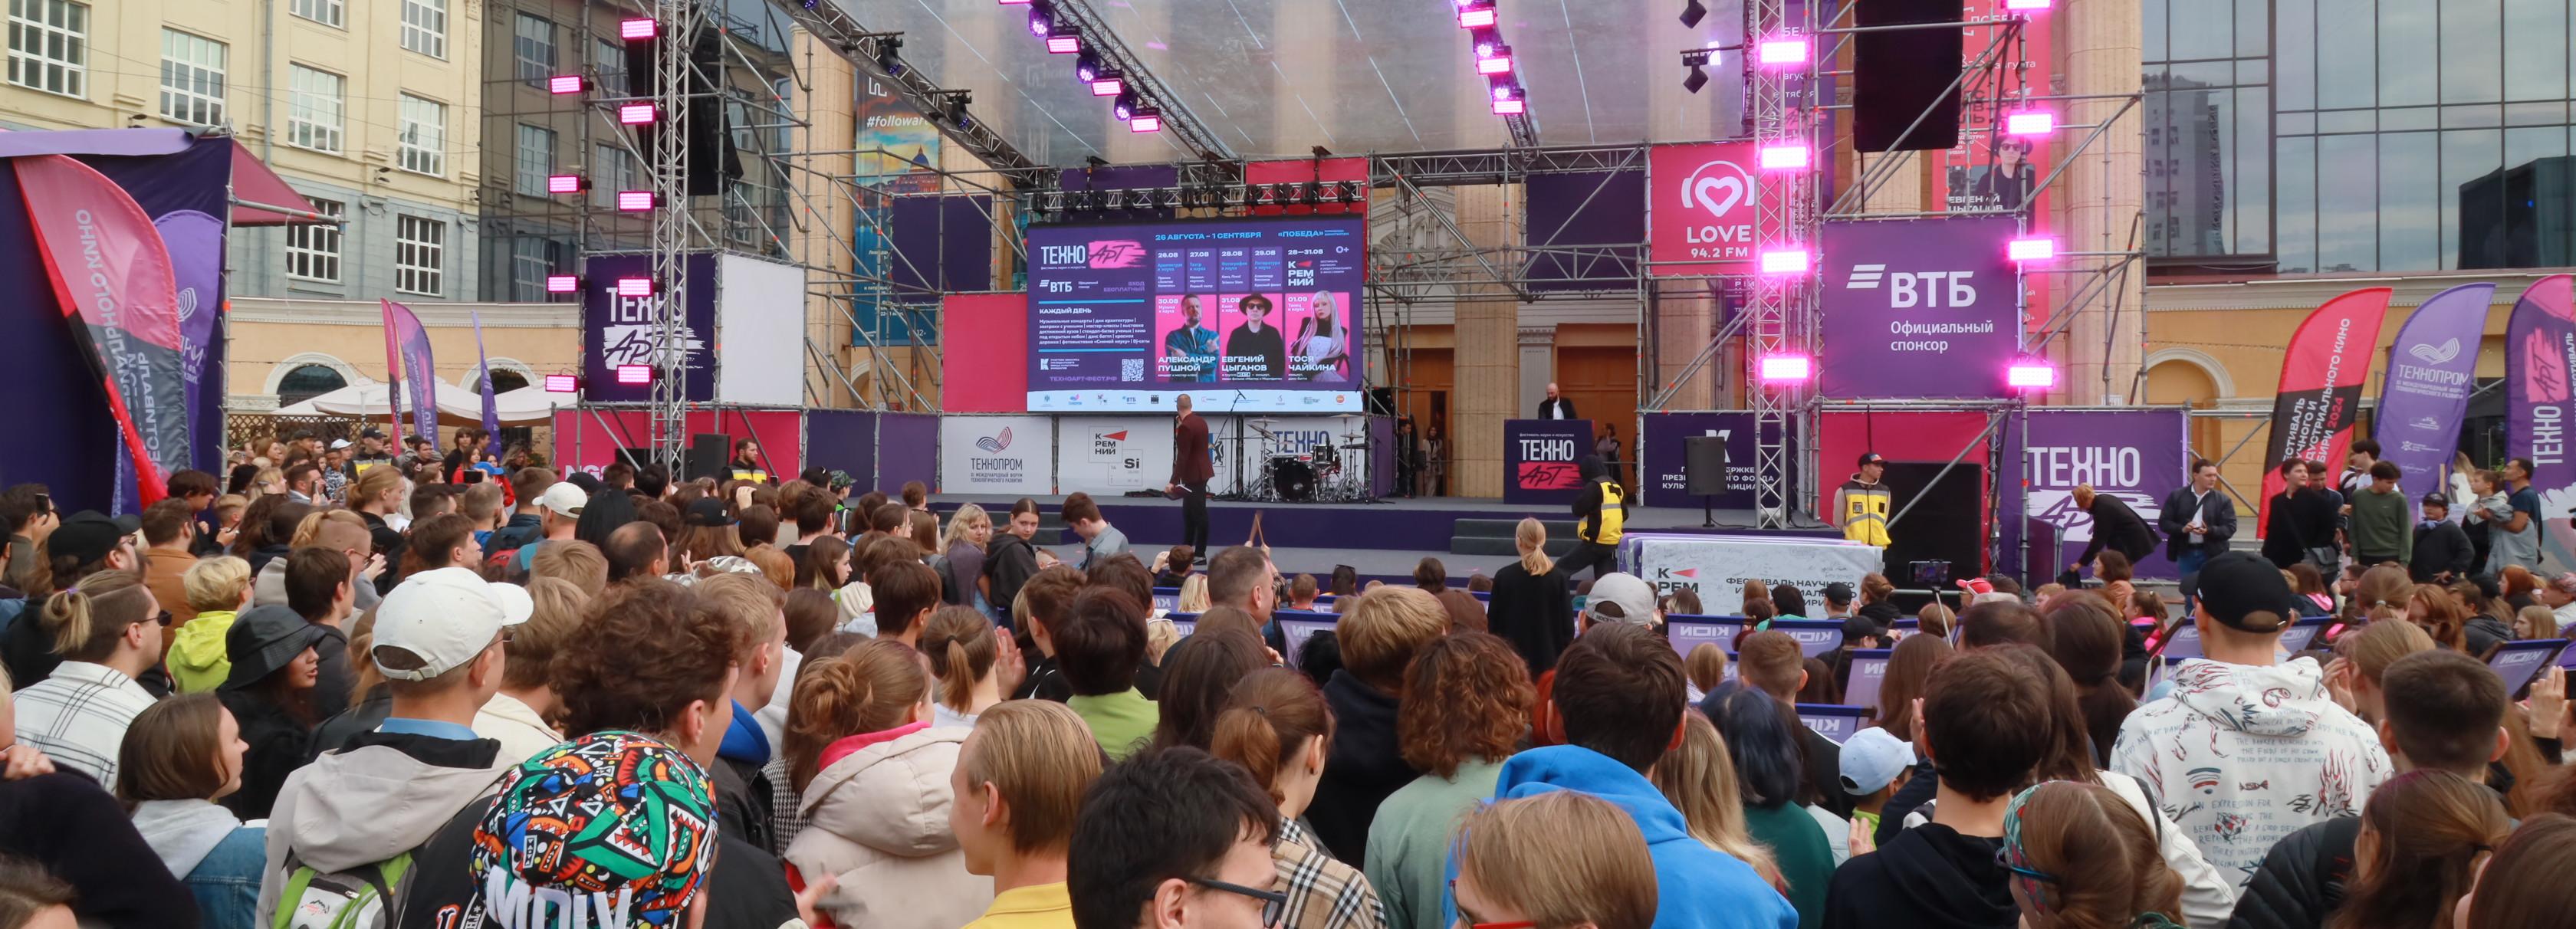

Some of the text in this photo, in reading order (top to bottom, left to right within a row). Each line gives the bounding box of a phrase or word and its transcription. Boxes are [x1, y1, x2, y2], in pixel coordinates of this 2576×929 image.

[1687, 225, 1751, 243] LOVE
[1041, 245, 1135, 264] ТЕХНО АРТ
[1691, 247, 1748, 258] 94.2 FM
[1288, 261, 1296, 269] К
[1050, 281, 1073, 292] ВТБ
[1288, 277, 1314, 286] НИЙ
[1891, 271, 1976, 307] ВТБ
[1891, 320, 1993, 336] Официальный
[2337, 318, 2350, 353] КИНО
[1891, 340, 1948, 353] спонсор
[1222, 354, 1264, 363] ЕВГЕНИЙ
[1158, 363, 1201, 372] ПУШНОЙ
[1222, 364, 1267, 373] ЦЫГАНОВ
[1288, 363, 1336, 372] ЧАЙКИНА
[2532, 343, 2563, 468] ТЕХНО АРТ
[2317, 396, 2344, 463] БИРИ 2024
[1520, 439, 1574, 461] ТЕХНО
[971, 458, 1023, 471] ТЕХНОПРОМ
[1124, 458, 1140, 468] Si
[2026, 446, 2141, 487] ТЕХНО
[1519, 464, 1574, 487] АРТ
[1658, 568, 1670, 579] К
